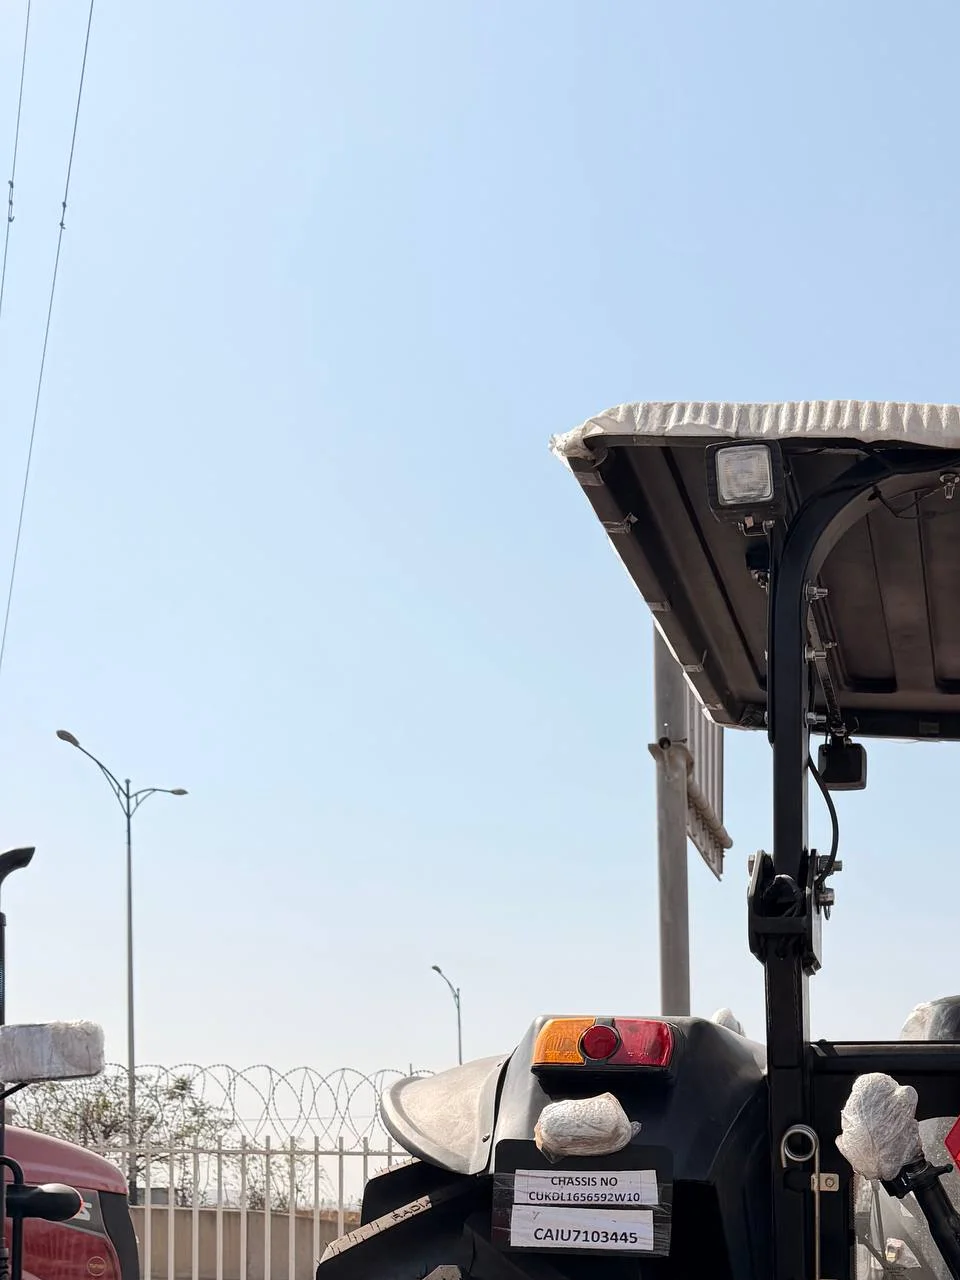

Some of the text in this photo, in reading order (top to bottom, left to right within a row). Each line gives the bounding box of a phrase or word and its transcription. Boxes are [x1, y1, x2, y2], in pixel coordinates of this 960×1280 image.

[551, 1176, 618, 1187] CHASSIS NO
[528, 1191, 640, 1202] CUKDL1656592W10
[533, 1228, 638, 1244] CAIU7103445
